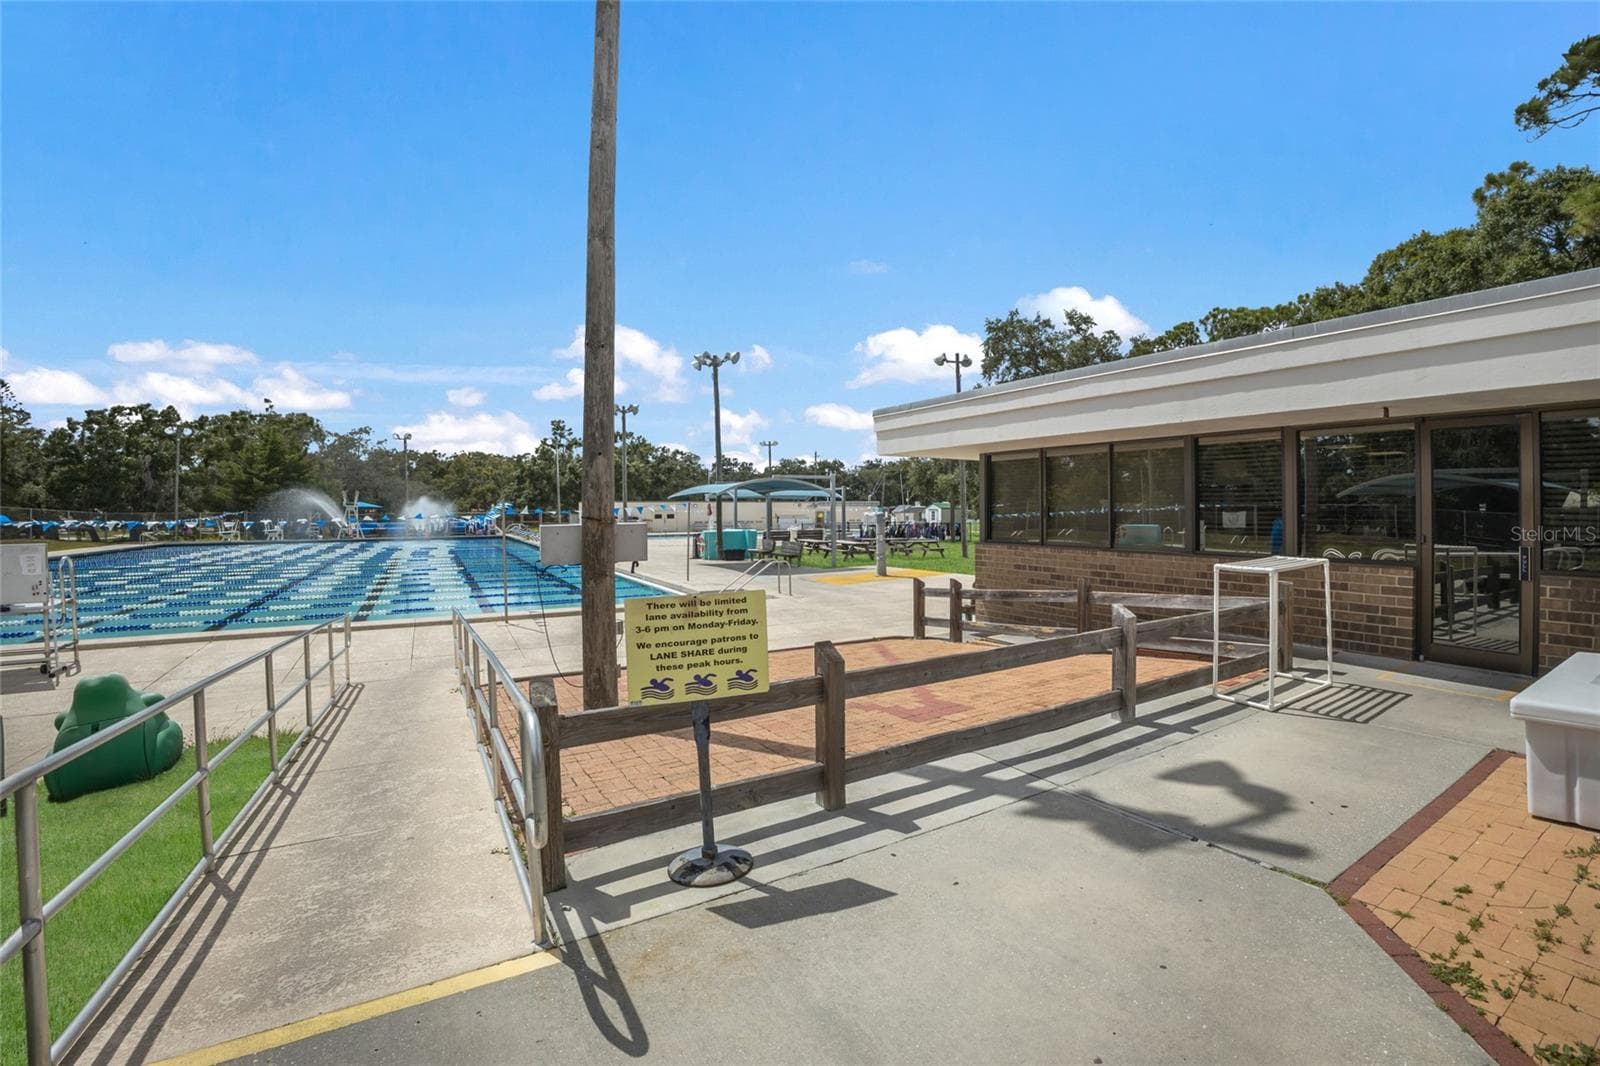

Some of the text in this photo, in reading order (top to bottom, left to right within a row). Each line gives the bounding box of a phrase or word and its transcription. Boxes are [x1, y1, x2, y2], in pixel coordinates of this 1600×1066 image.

[646, 602, 676, 610] There
[679, 599, 697, 608] will
[714, 596, 747, 606] limited
[645, 607, 748, 621] lane availability from
[635, 625, 651, 634] 3-6
[654, 626, 670, 634] pm
[687, 618, 759, 630] Monday-Friday.
[636, 641, 652, 649] We
[655, 638, 708, 648] encourage
[711, 634, 747, 645] patrons
[650, 646, 748, 661] LANE SHARE during
[655, 657, 744, 672] these peak hours.
